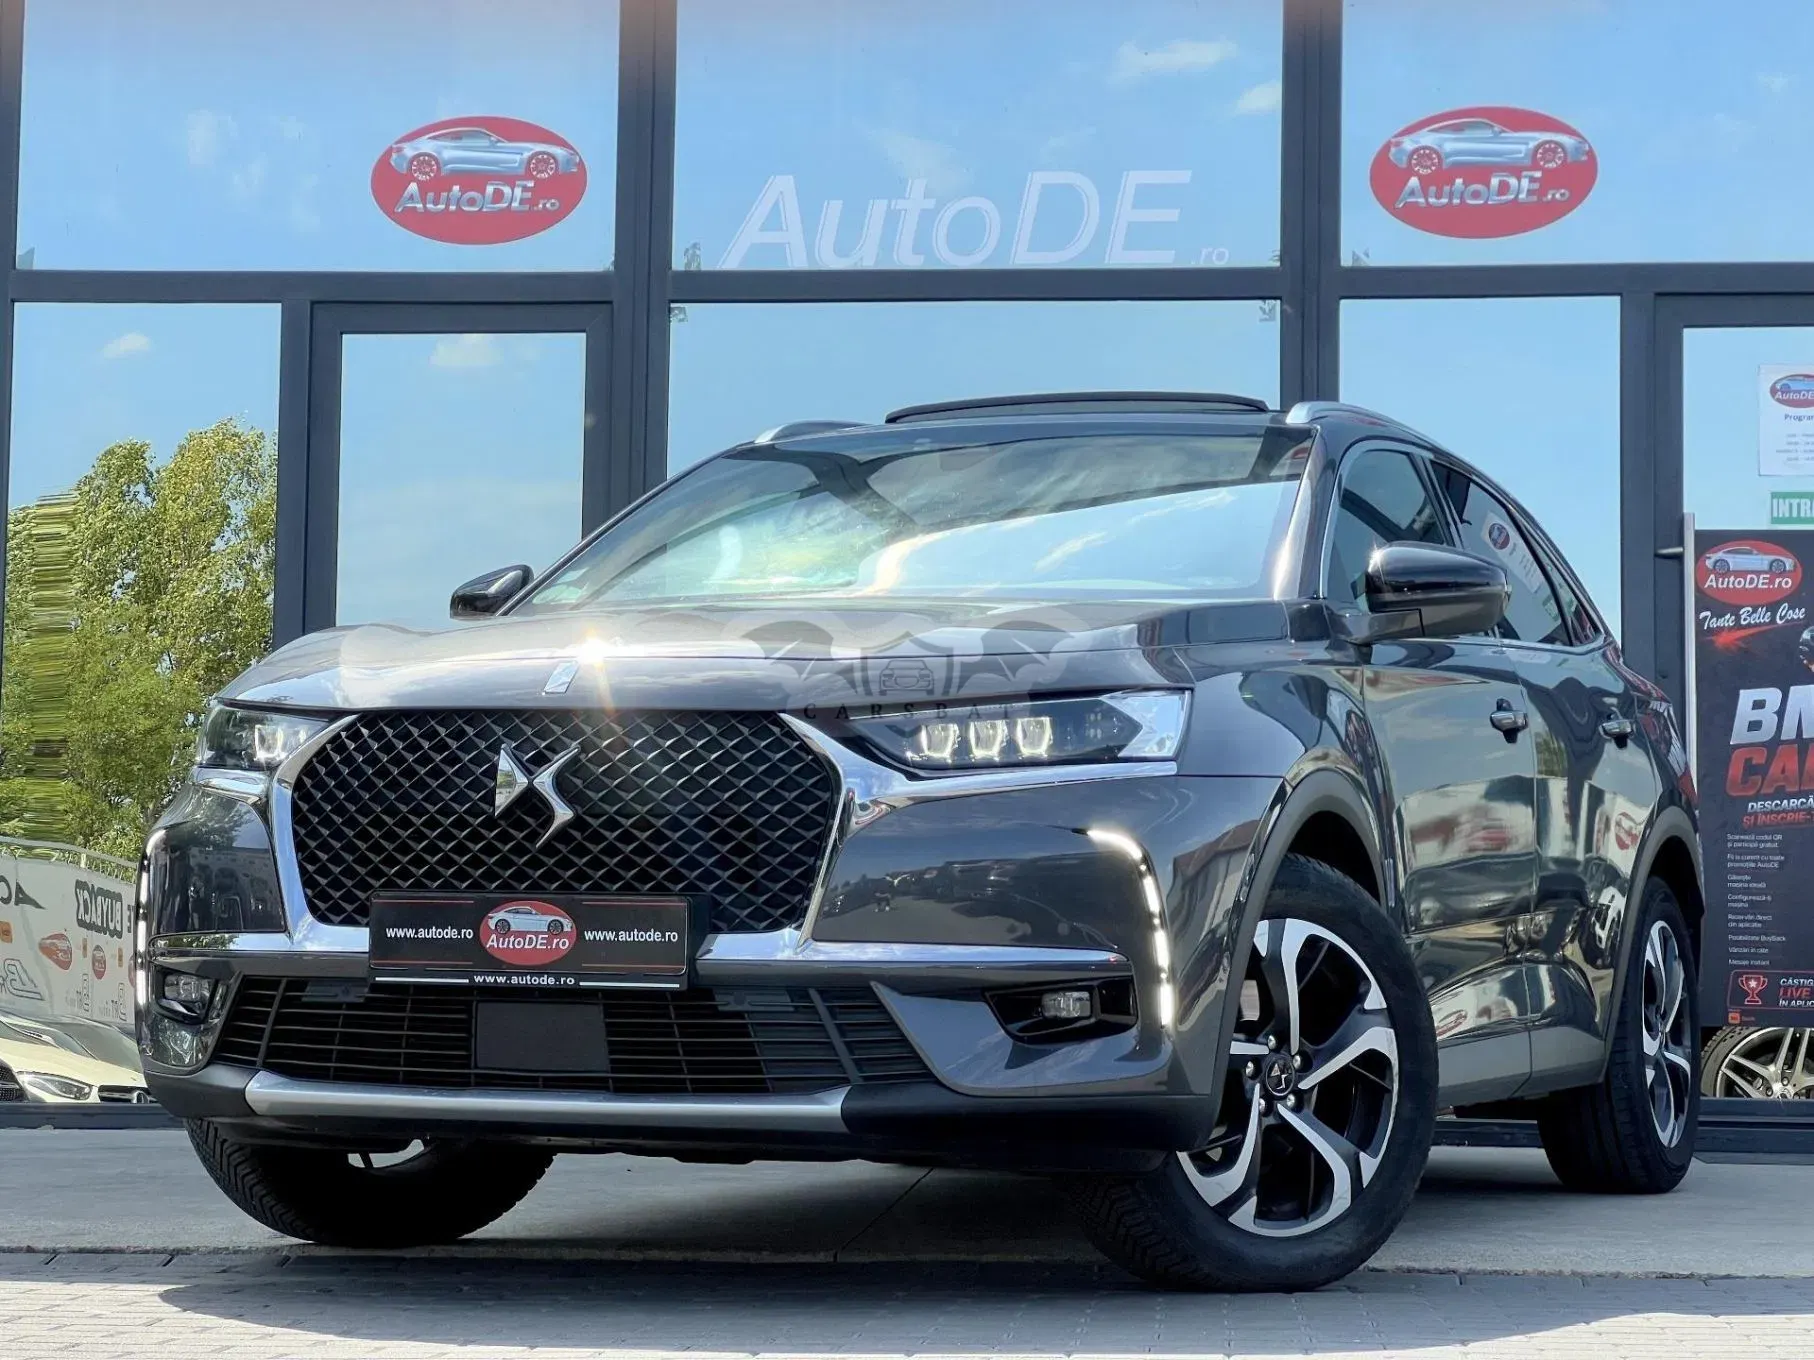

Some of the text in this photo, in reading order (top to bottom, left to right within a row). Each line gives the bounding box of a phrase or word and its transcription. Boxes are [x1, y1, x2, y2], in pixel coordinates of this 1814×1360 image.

[1704, 574, 1793, 590] AutoDE.ro
[1699, 602, 1806, 630] Tante Belle Cose
[386, 926, 474, 940] www.autode.ro
[584, 928, 679, 943] www.autode.ro
[486, 934, 570, 951] AutoDE.ro
[473, 974, 575, 985] www.autode.ro
